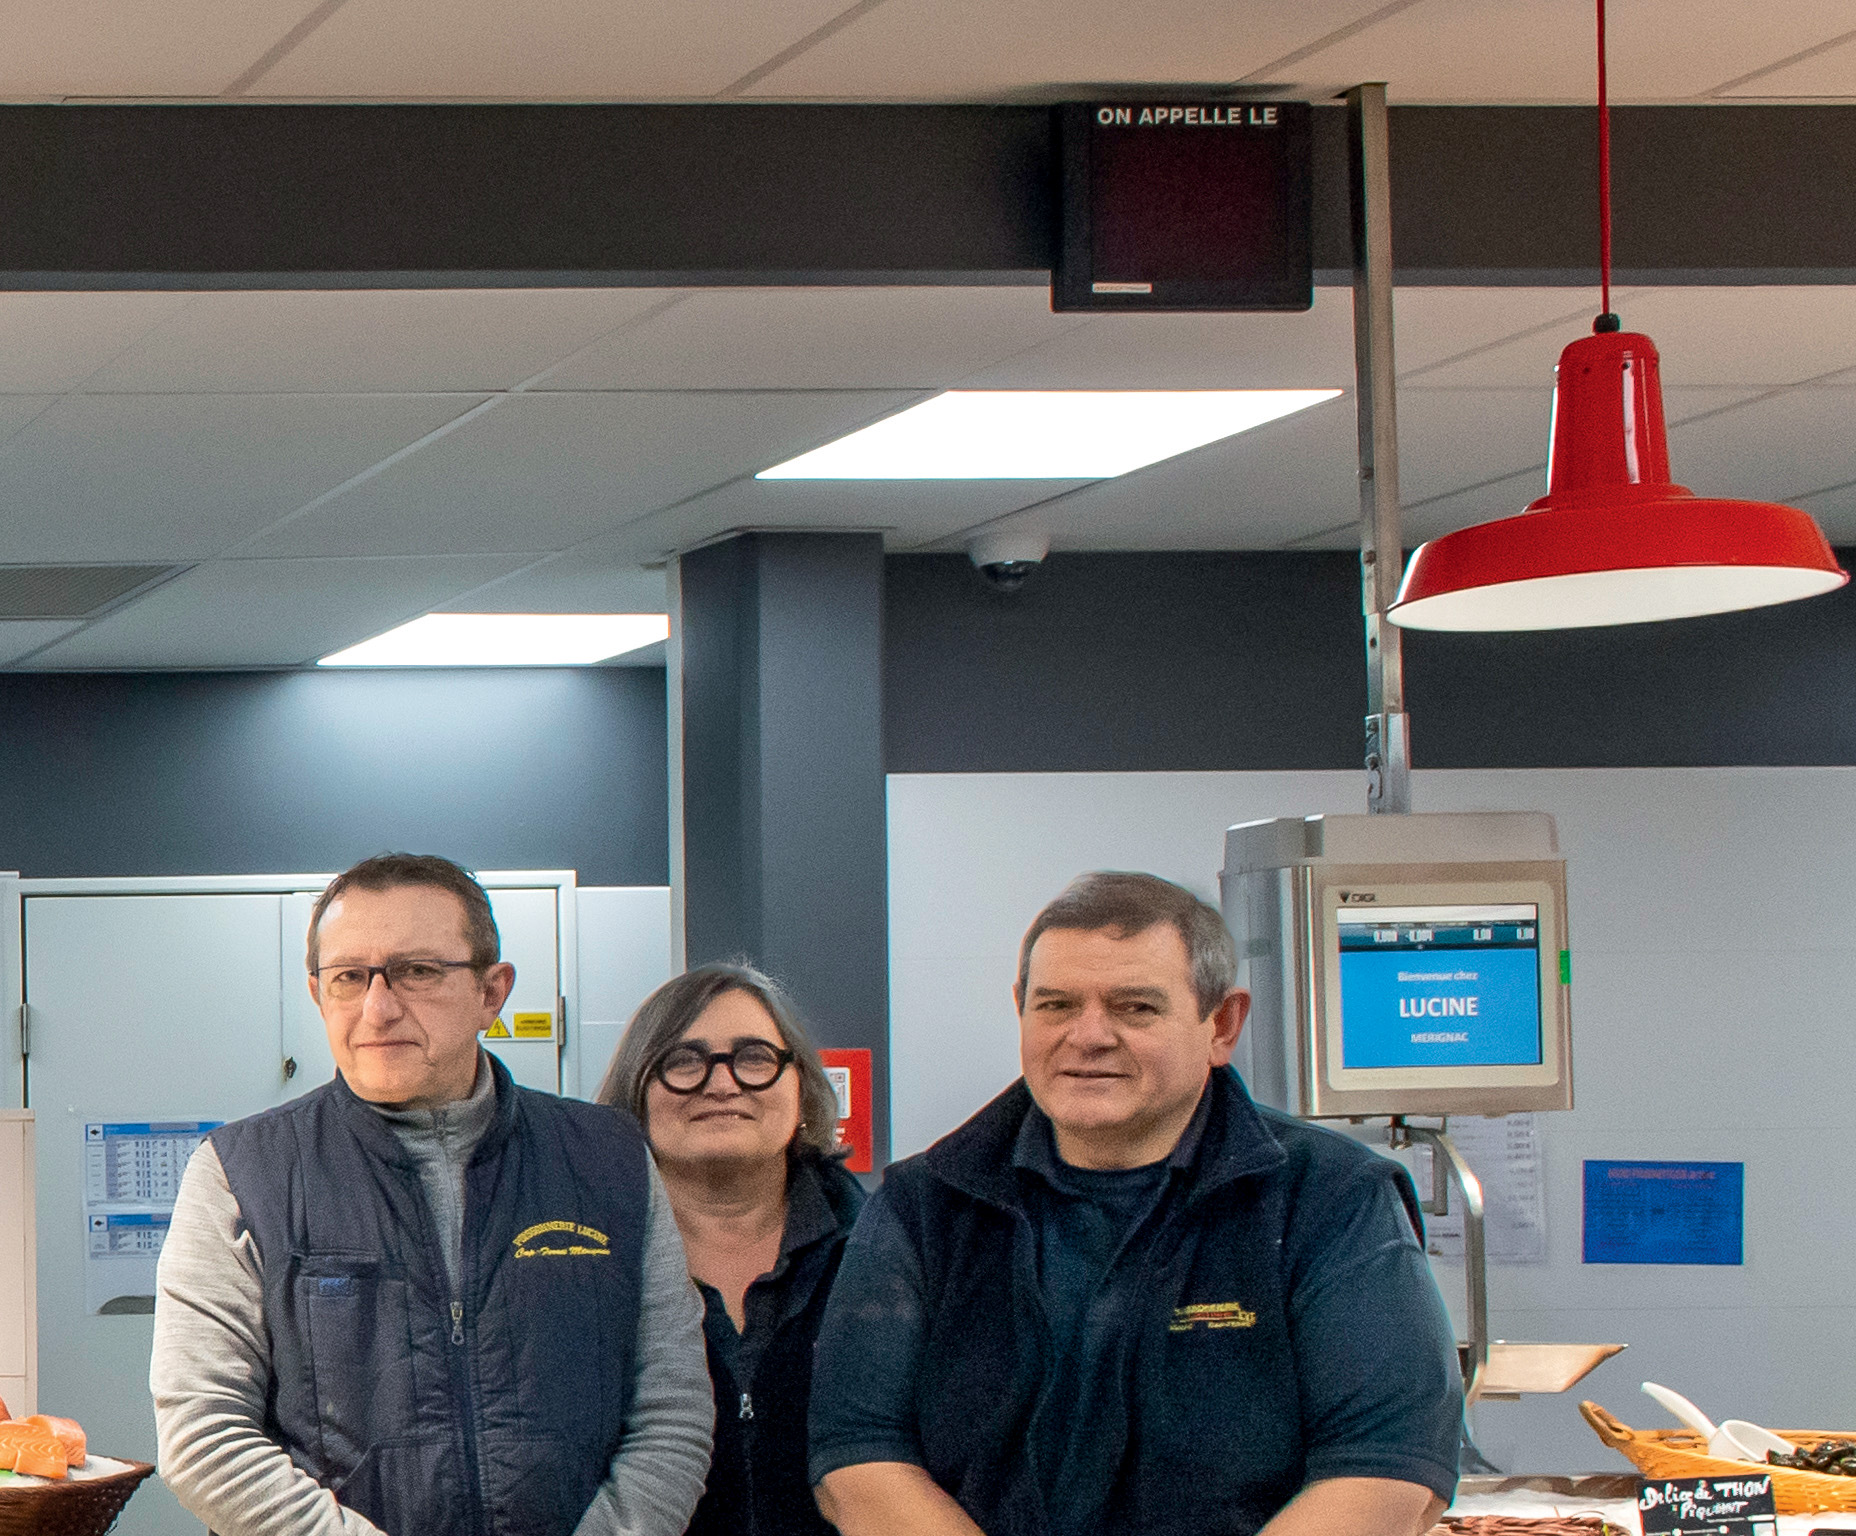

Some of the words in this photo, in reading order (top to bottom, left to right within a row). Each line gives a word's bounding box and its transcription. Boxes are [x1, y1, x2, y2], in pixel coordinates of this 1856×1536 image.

[1097, 107, 1132, 125] ON
[1139, 107, 1242, 125] APPELLE
[1249, 107, 1278, 125] LE
[1397, 971, 1453, 982] Bienvenue
[1454, 970, 1478, 981] chez
[1399, 997, 1479, 1018] LUCINE
[1411, 1032, 1469, 1043] MERIGNAC
[1713, 1475, 1772, 1498] THON
